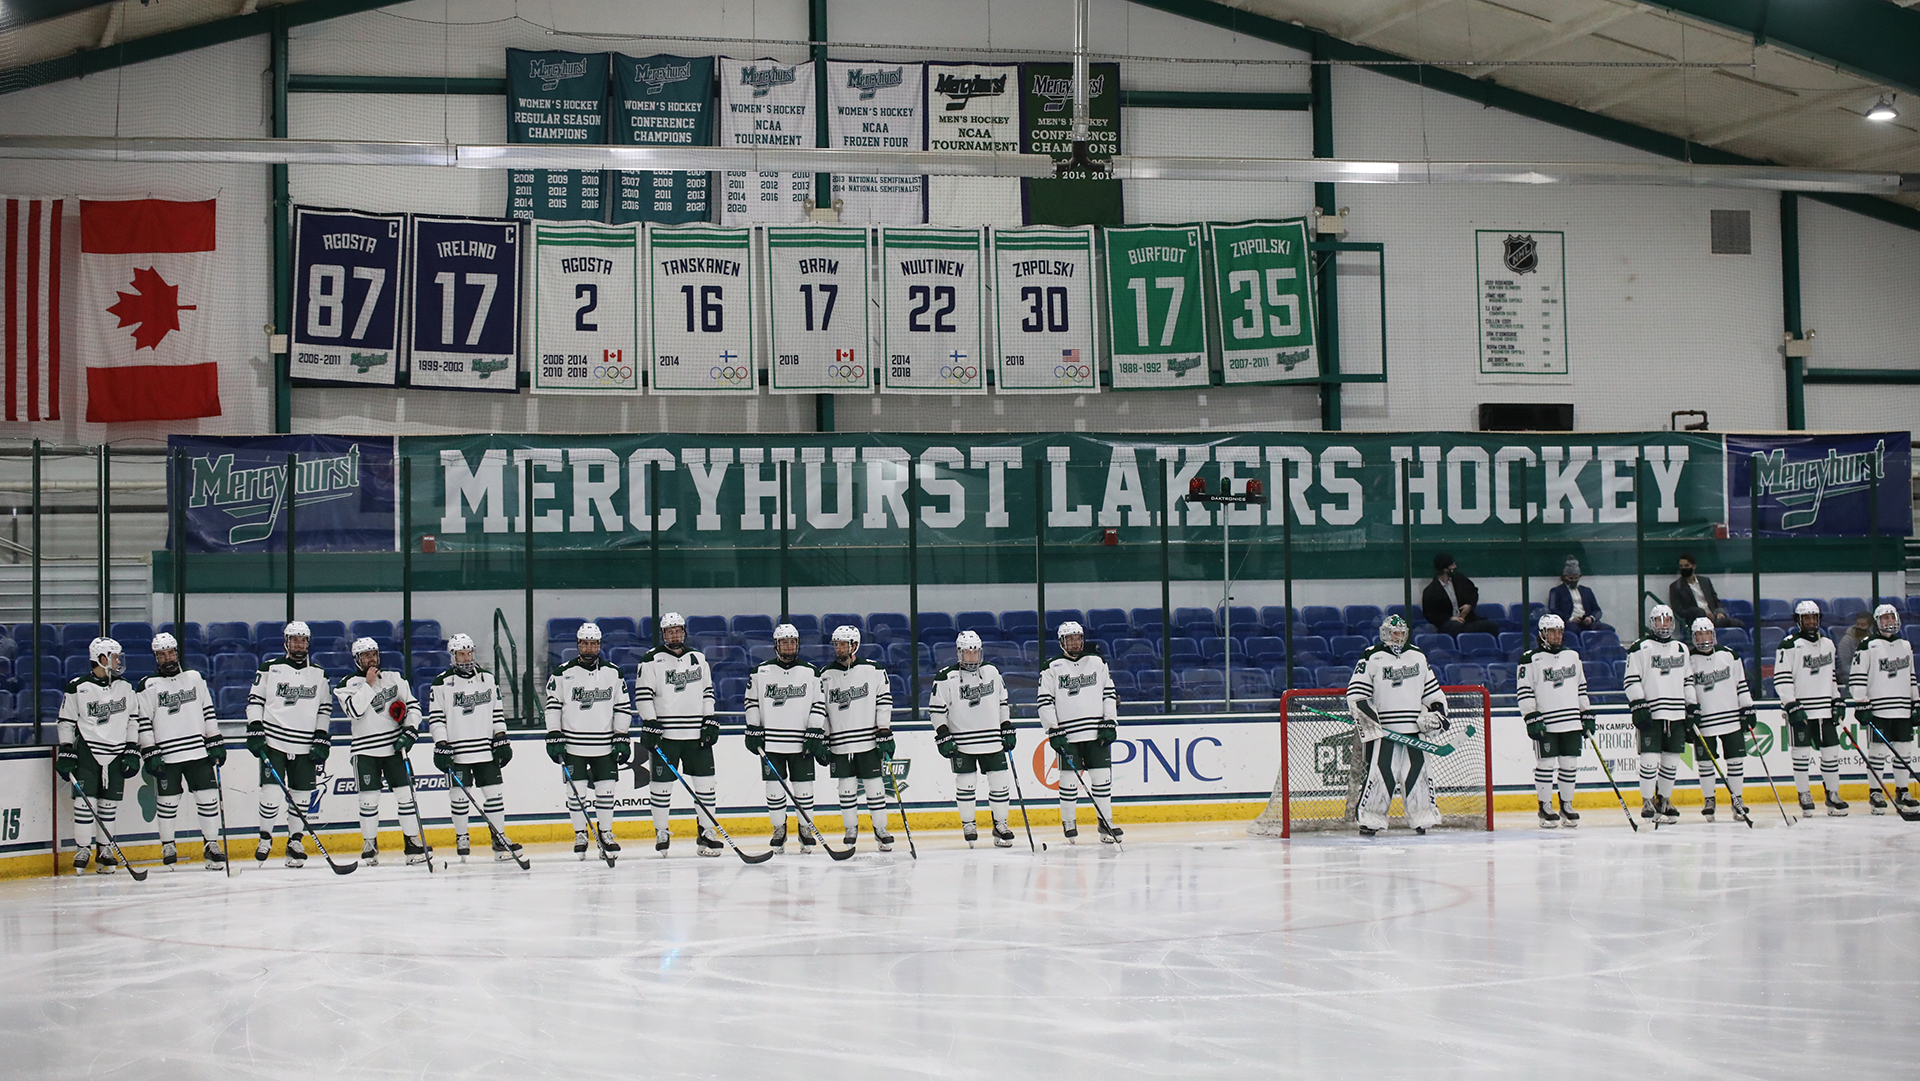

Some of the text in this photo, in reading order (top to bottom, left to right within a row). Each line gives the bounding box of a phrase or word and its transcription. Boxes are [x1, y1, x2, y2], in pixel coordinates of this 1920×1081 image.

[530, 58, 588, 83] Mercyhurst
[847, 67, 903, 91] Mercyhurst
[518, 98, 598, 110] WOMEN'S HOCKEY
[624, 101, 702, 112] WOMEN'S HOCKEY
[730, 103, 806, 115] WOMEN'S HOCKEY
[838, 106, 914, 117] WOMEN'S HOCKEY
[514, 112, 601, 126] REGULAR SEASON
[631, 116, 695, 129] CONFERENCE
[939, 115, 1010, 125] MEN'S HOCKEY
[1038, 118, 1109, 126] MEN'S HKEY
[756, 120, 781, 131] NCAA
[863, 122, 889, 133] NCAA
[528, 127, 588, 140] CHAMPIONS
[634, 131, 692, 143] CHAMPIONS
[958, 128, 992, 139] NCAA
[1031, 130, 1117, 142] CONFEENCE
[735, 133, 802, 146] TOURNAMENT
[844, 136, 909, 148] FROZEN FOUR
[932, 139, 1018, 152] TOURNAMENT
[1032, 142, 1117, 153] CHAMONS
[513, 174, 535, 183] 2008
[547, 175, 568, 184] 2009
[581, 176, 599, 185] 2010
[621, 176, 640, 186] 2007
[848, 176, 878, 184] NATIONAL
[1062, 171, 1087, 180] 2014
[653, 178, 673, 187] 2008
[686, 178, 706, 188] 2009
[729, 180, 745, 189] 2011
[760, 181, 779, 190] 2012
[792, 181, 810, 191] 2013
[515, 186, 532, 195] 2011
[548, 187, 567, 196] 2012
[581, 188, 599, 197] 2013
[622, 189, 639, 198] 2010
[655, 190, 671, 199] 2011
[687, 190, 706, 200] 2013
[728, 191, 746, 201] 2014
[514, 198, 533, 207] 2014
[760, 192, 779, 202] 2016
[548, 199, 567, 208] 2015
[581, 200, 599, 209] 2016
[621, 201, 639, 210] 2016
[654, 202, 672, 211] 2018
[686, 202, 706, 212] 2020
[727, 203, 747, 213] 2020
[513, 210, 534, 219] 2020
[388, 221, 398, 238] C
[505, 226, 514, 244] C
[322, 233, 378, 254] AGOSTA
[1188, 232, 1196, 247] C
[436, 240, 497, 260] IRELAND
[1230, 238, 1291, 259] ZAPOLSKI
[1128, 246, 1187, 265] BURFOOT
[1512, 244, 1531, 266] NHL
[561, 257, 613, 275] AGOSTA
[661, 258, 741, 278] TANSKANEN
[799, 258, 839, 275] BRAM
[900, 259, 965, 278] NUUTINEN
[1013, 260, 1075, 278] ZAPOLSKI
[306, 263, 386, 340] 87
[575, 283, 598, 331] 2
[1228, 267, 1300, 340] 35
[434, 271, 498, 346] 17
[681, 285, 723, 332] 16
[799, 284, 839, 331] 17
[909, 285, 956, 332] 22
[1021, 286, 1069, 333] 30
[1127, 276, 1185, 347] 17
[298, 353, 341, 366] 2006-2011
[543, 355, 588, 365] 2006 2014
[660, 356, 679, 366] 2014
[779, 355, 799, 365] 2018
[891, 355, 910, 365] 2014
[1005, 356, 1025, 366] 2018
[1230, 357, 1269, 370] 2007-2011
[418, 360, 464, 372] 1999-2003
[1119, 362, 1161, 373] 1988-1992
[543, 367, 588, 378] 2010 2018
[891, 367, 911, 378] 2018
[1751, 439, 1886, 506] Mercyhurst
[189, 443, 360, 516] Mercyhurst
[440, 445, 1689, 533] MERCYHURST LAKERS HOCKEY
[1389, 733, 1438, 752] BAUER
[1111, 737, 1223, 783] PNC
[2, 808, 21, 841] 15
